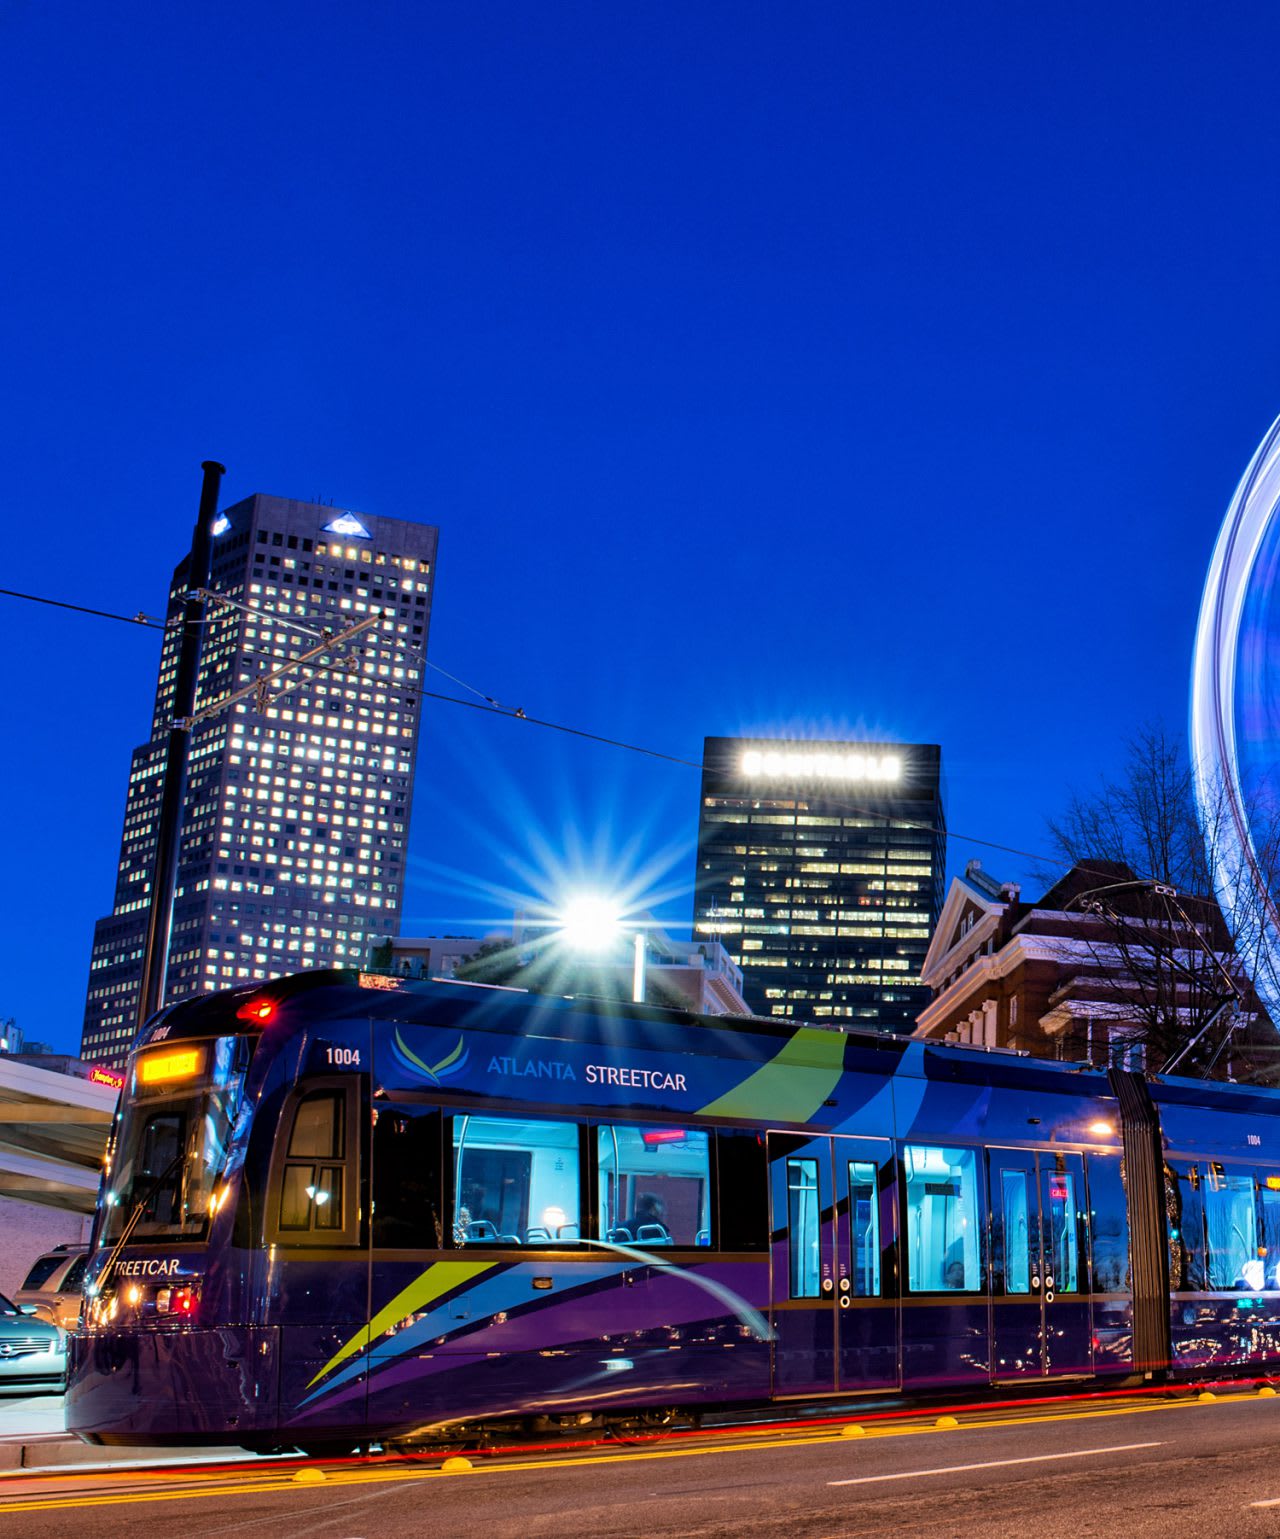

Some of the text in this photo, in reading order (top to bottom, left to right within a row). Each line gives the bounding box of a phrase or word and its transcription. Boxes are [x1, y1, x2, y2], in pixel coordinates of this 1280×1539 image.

[326, 1047, 361, 1065] 1004
[487, 1055, 687, 1091] ATLANTA STREETCAR
[1247, 1135, 1261, 1145] 1004
[113, 1259, 180, 1276] TREETCAR
